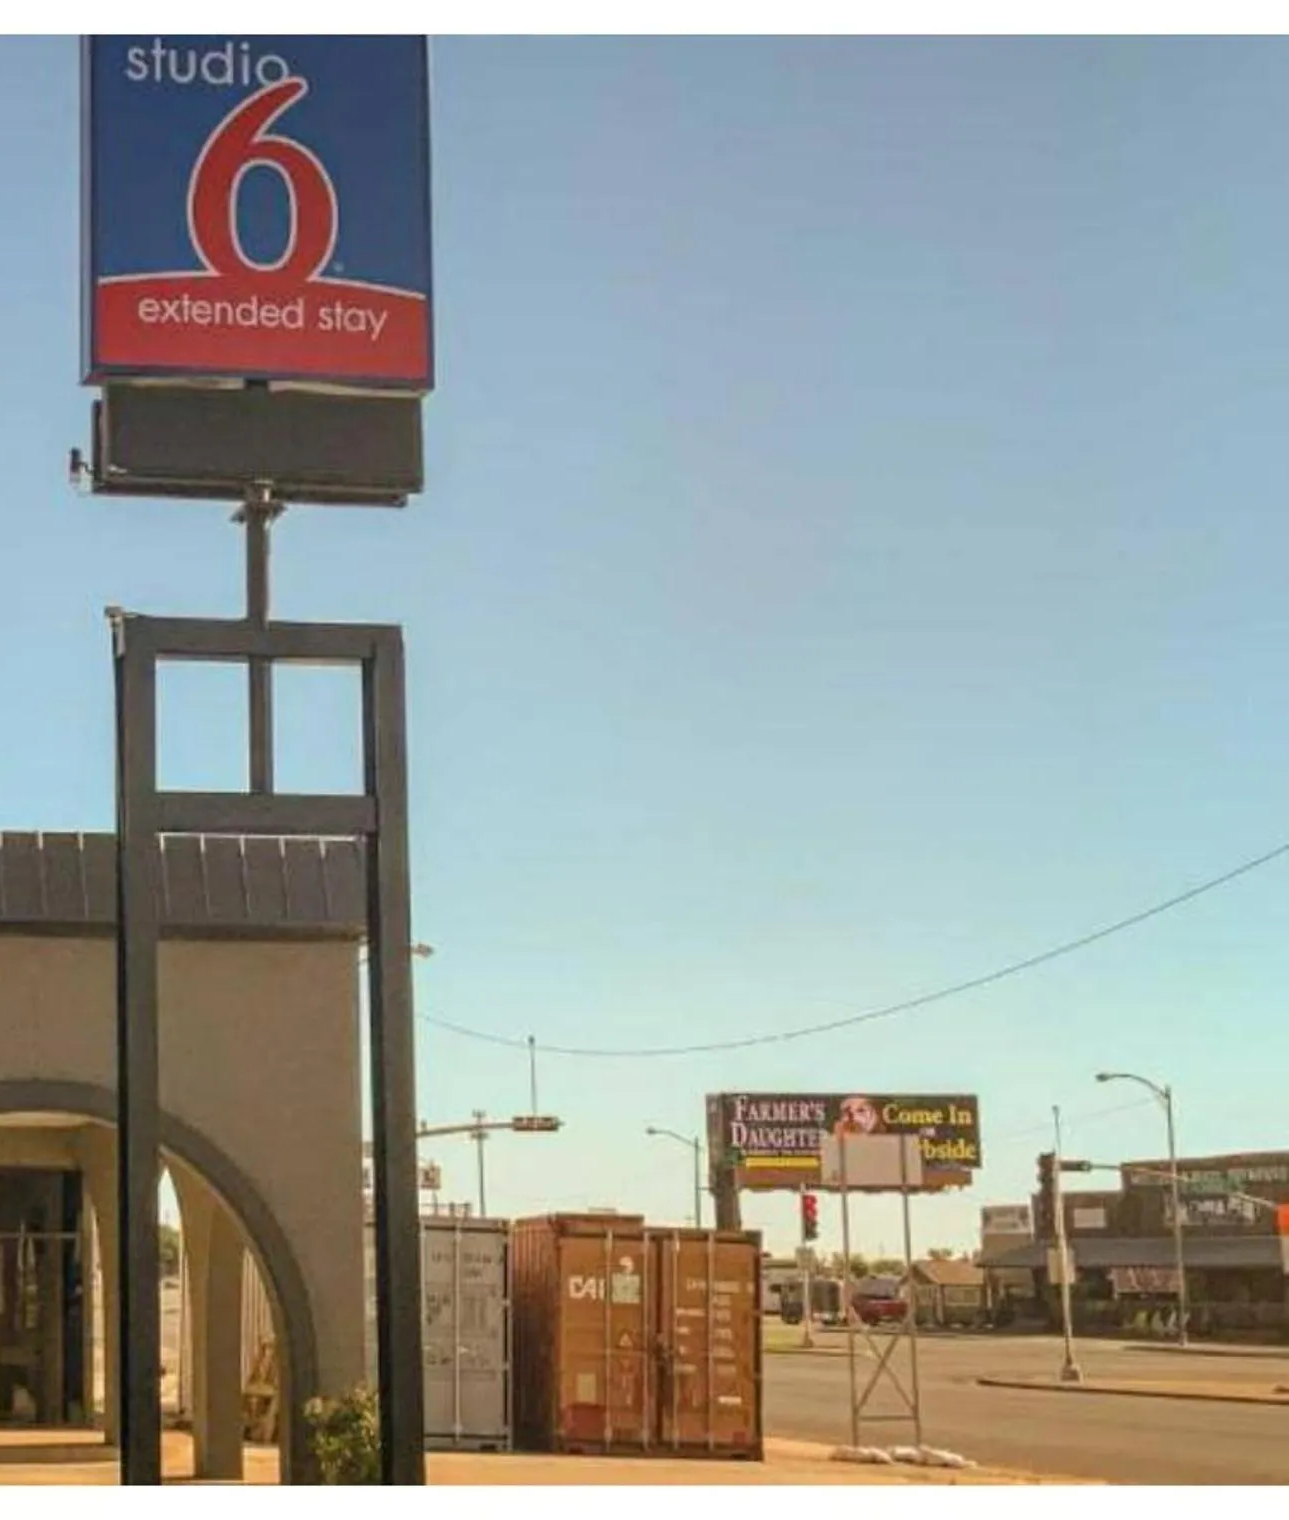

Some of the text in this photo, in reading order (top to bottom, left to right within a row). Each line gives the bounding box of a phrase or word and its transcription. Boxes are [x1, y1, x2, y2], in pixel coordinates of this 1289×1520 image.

[126, 37, 290, 86] studio
[187, 76, 339, 282] 6
[138, 294, 389, 341] extended stay
[882, 1103, 972, 1125] Come In
